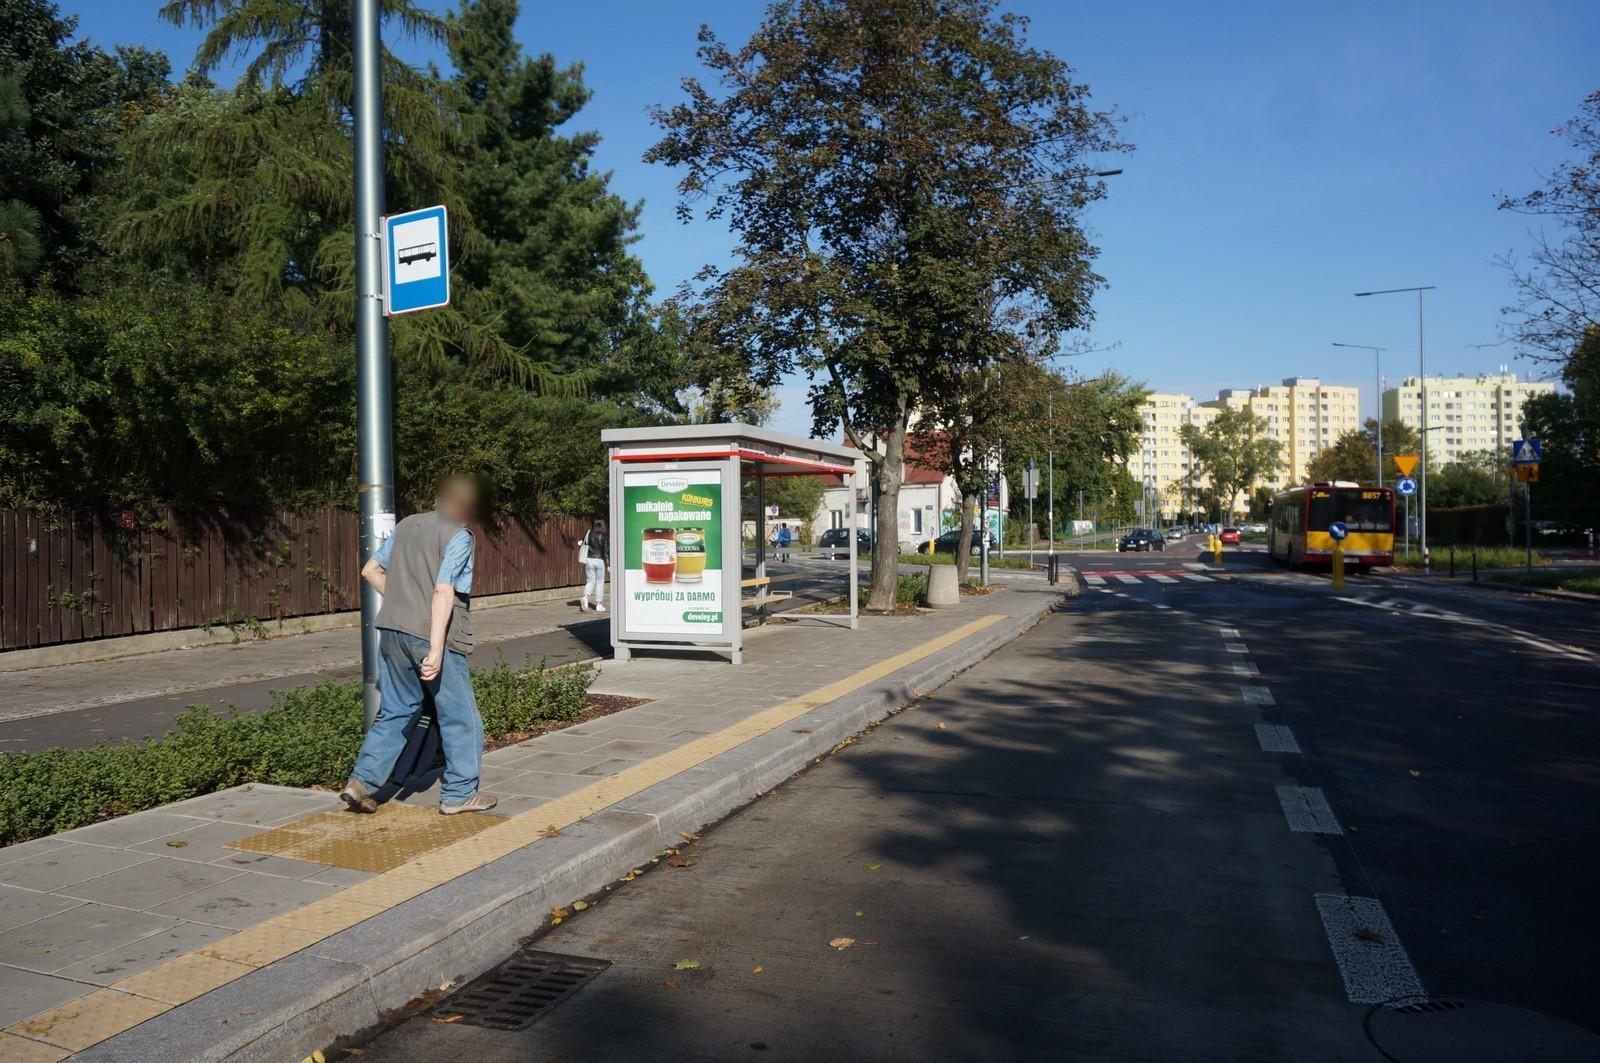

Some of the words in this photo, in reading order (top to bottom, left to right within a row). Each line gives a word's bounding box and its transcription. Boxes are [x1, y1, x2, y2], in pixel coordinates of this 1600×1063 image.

[661, 480, 685, 488] Develey
[682, 493, 713, 507] KONKURS
[636, 501, 673, 512] unikalnie
[634, 590, 673, 602] wypróbuj
[675, 591, 685, 601] ZA
[687, 591, 715, 601] DARMO
[687, 613, 718, 622] develey.pl
